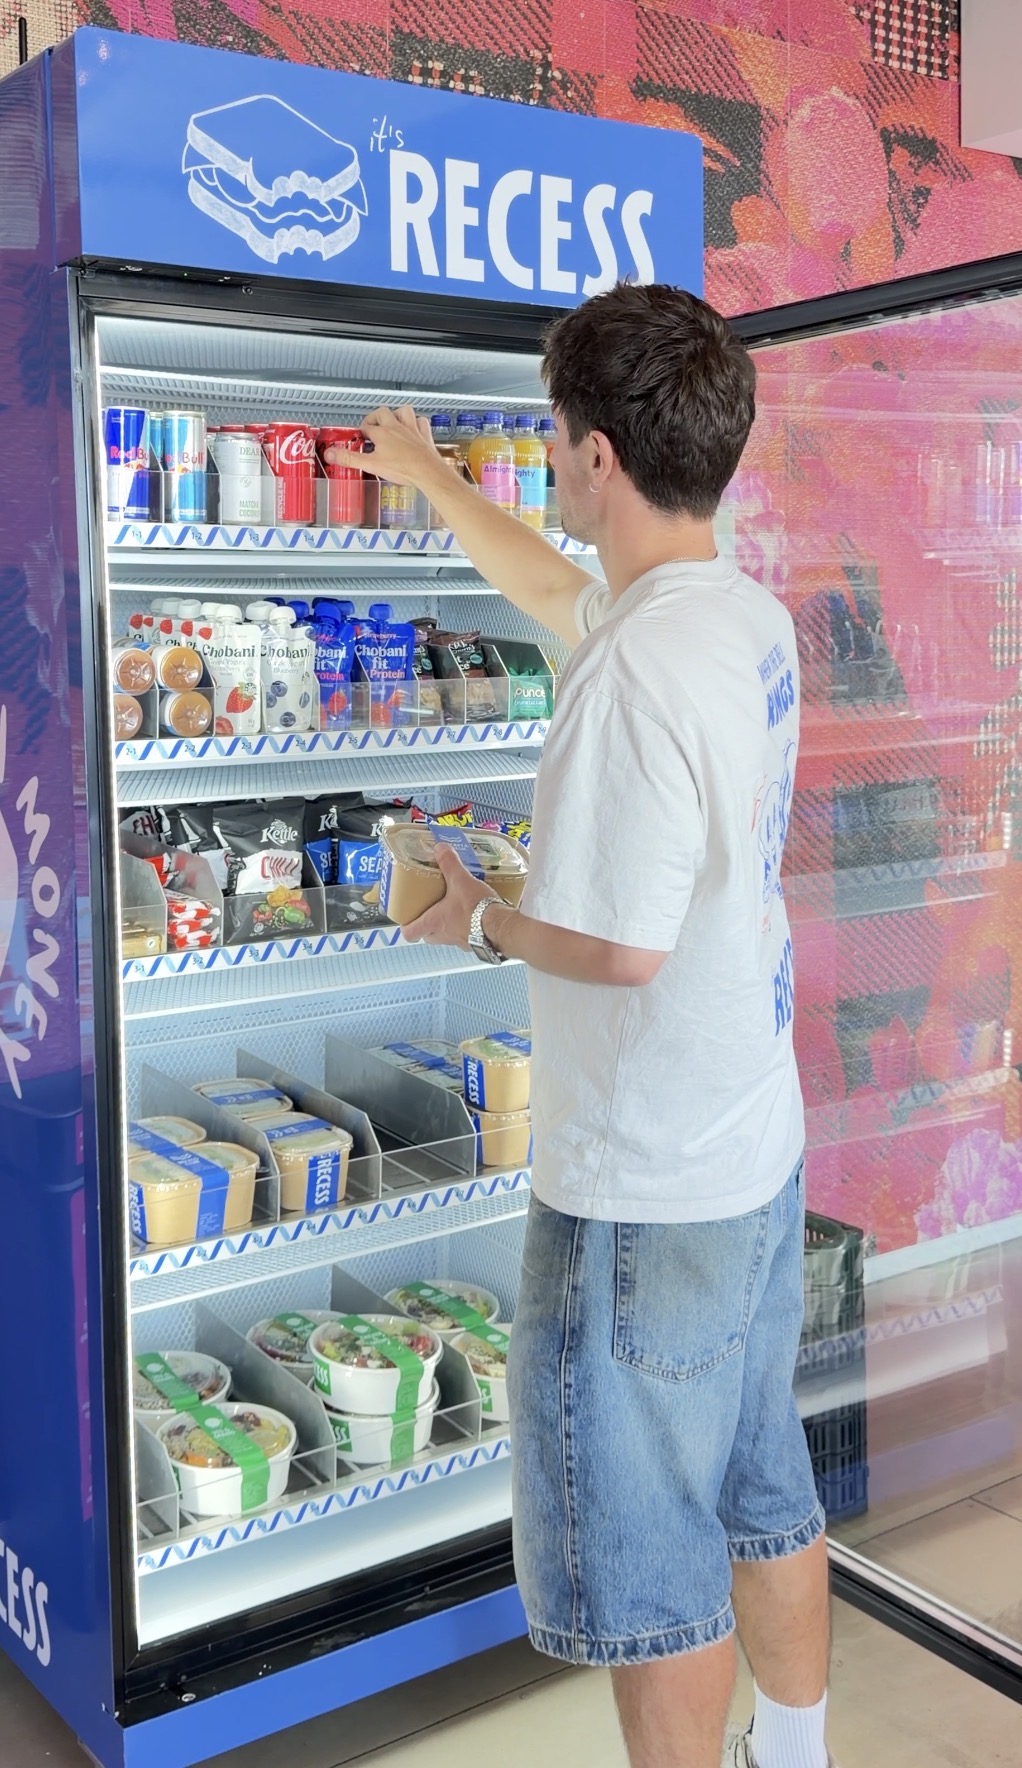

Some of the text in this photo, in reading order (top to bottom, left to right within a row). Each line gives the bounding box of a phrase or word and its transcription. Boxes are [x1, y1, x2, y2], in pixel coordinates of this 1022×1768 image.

[370, 115, 404, 153] it's
[389, 148, 655, 298] RECESS
[131, 530, 142, 538] 1-1
[191, 532, 202, 540] 1-2
[249, 533, 260, 541] 1-3
[202, 644, 256, 658] Chobani
[354, 644, 407, 658] Chobani
[372, 657, 388, 670] fit
[370, 669, 405, 679] Protein
[398, 733, 407, 741] 2-6
[447, 731, 456, 739] 2-7
[295, 739, 306, 747] 2-4
[348, 736, 358, 744] 2-5
[260, 824, 299, 844] Kettle
[354, 936, 364, 945] 3-5
[302, 942, 313, 951] 3-4
[249, 949, 259, 958] 3-3
[192, 956, 203, 965] 3-2
[134, 965, 145, 973] 3-1
[467, 1060, 480, 1105] RECESS
[314, 1158, 332, 1205] RECESS
